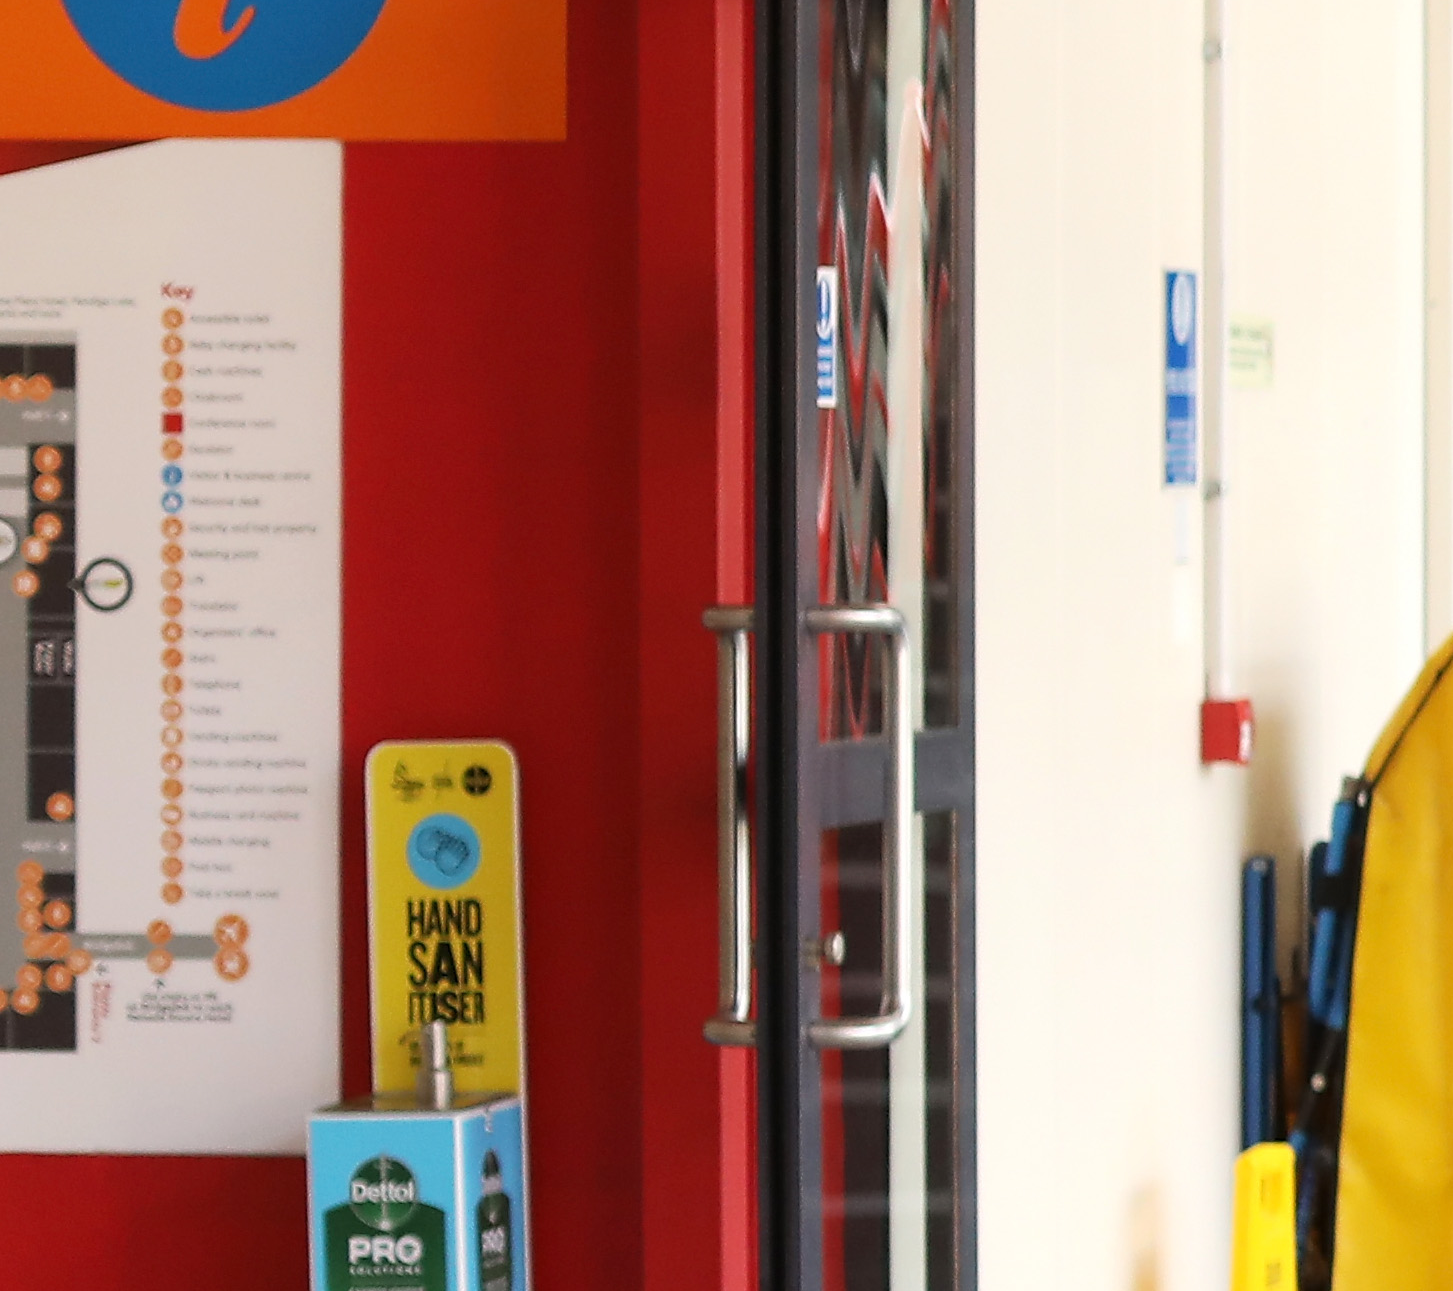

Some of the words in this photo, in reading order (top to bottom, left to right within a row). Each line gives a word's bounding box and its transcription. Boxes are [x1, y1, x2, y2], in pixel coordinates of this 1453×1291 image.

[407, 898, 483, 937] HAND
[407, 940, 483, 987] SAN
[351, 1179, 416, 1203] Dettol
[347, 1234, 424, 1265] PRO
